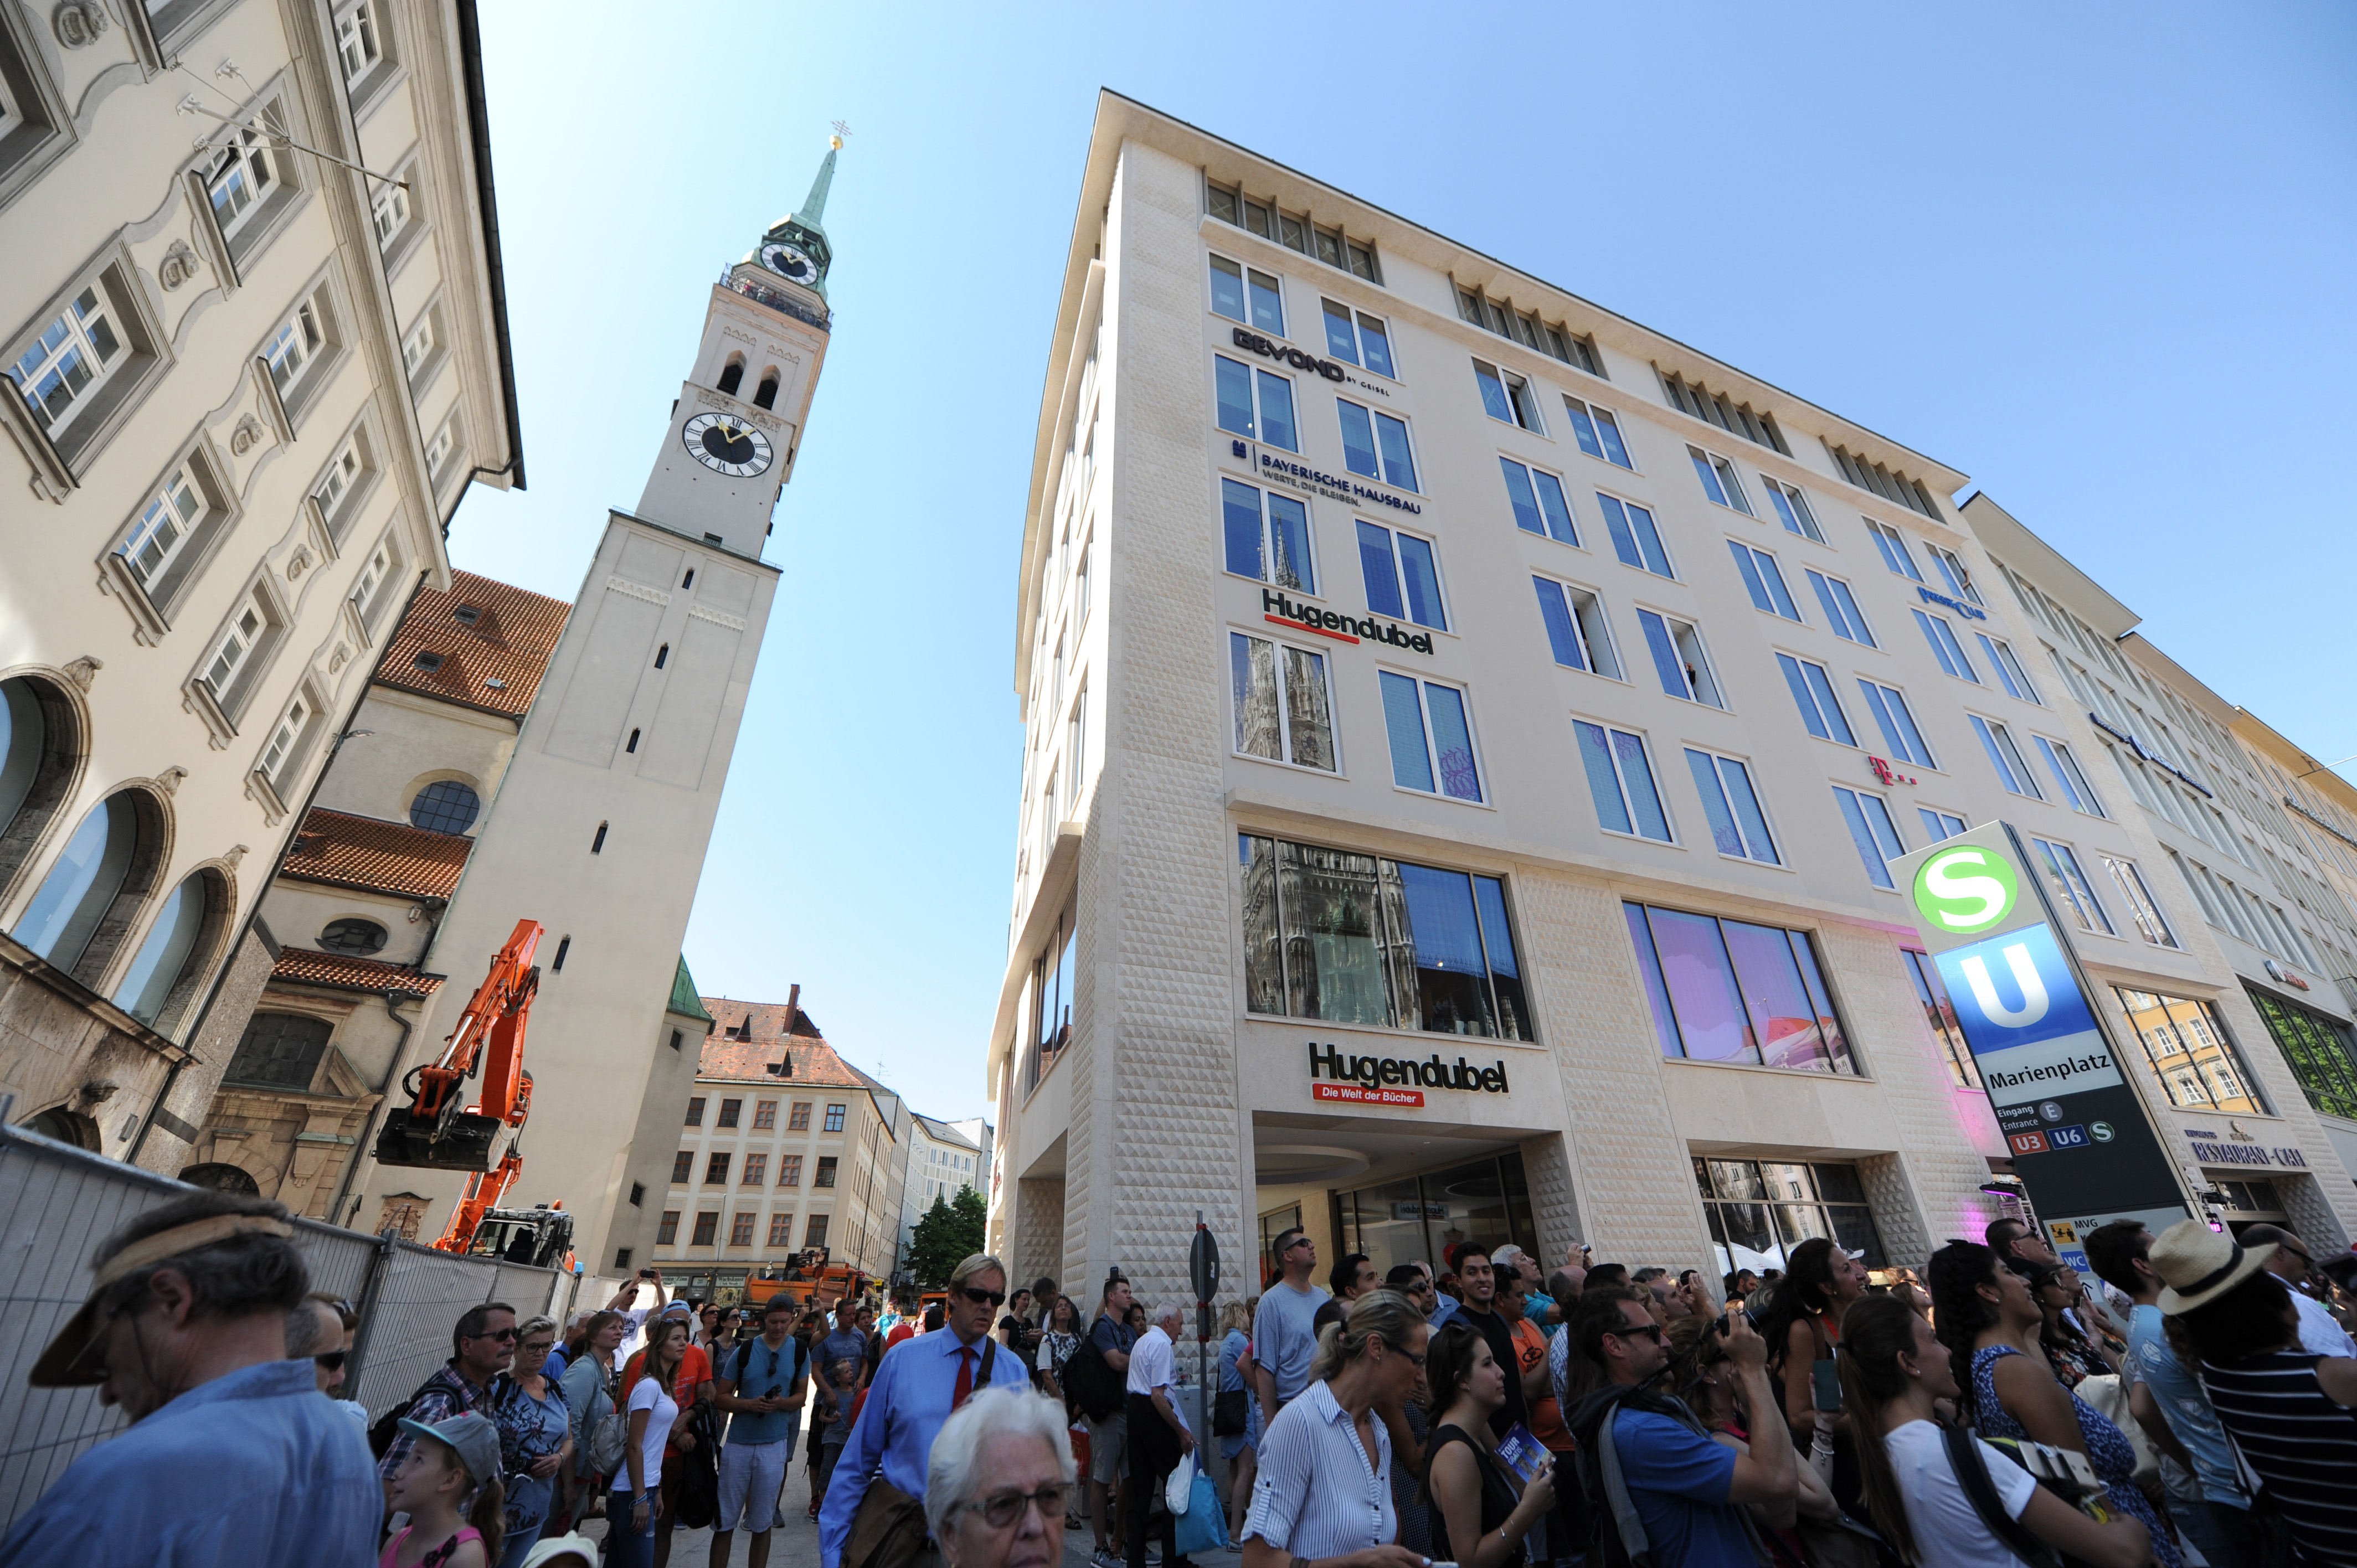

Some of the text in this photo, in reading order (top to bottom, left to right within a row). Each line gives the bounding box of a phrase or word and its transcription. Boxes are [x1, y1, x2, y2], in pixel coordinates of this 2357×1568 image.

[1233, 327, 1345, 383] BEYOND
[1360, 381, 1390, 396] GEISEL
[1262, 453, 1421, 515] BAYERISCHE HAUSBAU
[1263, 468, 1361, 508] WERTE, DIE BLEIBEN.
[1262, 588, 1434, 655] Hugendubel
[1925, 852, 2006, 927] S
[1959, 942, 2050, 1028] U
[1309, 1042, 1509, 1094] Hugendubel
[1989, 1053, 2111, 1090] Marienplatz
[1322, 1086, 1416, 1103] Die Welt der Bücher
[1997, 1106, 2034, 1118] Eingang
[2045, 1105, 2058, 1118] E
[2002, 1119, 2039, 1131] Entrance
[2092, 1123, 2112, 1140] S
[2015, 1136, 2041, 1151] U3
[2054, 1129, 2081, 1145] U6
[2074, 1219, 2098, 1229] MVG
[2065, 1255, 2087, 1266] WC
[1501, 1436, 1520, 1459] TOUR
[1507, 1446, 1522, 1466] GRATIS
